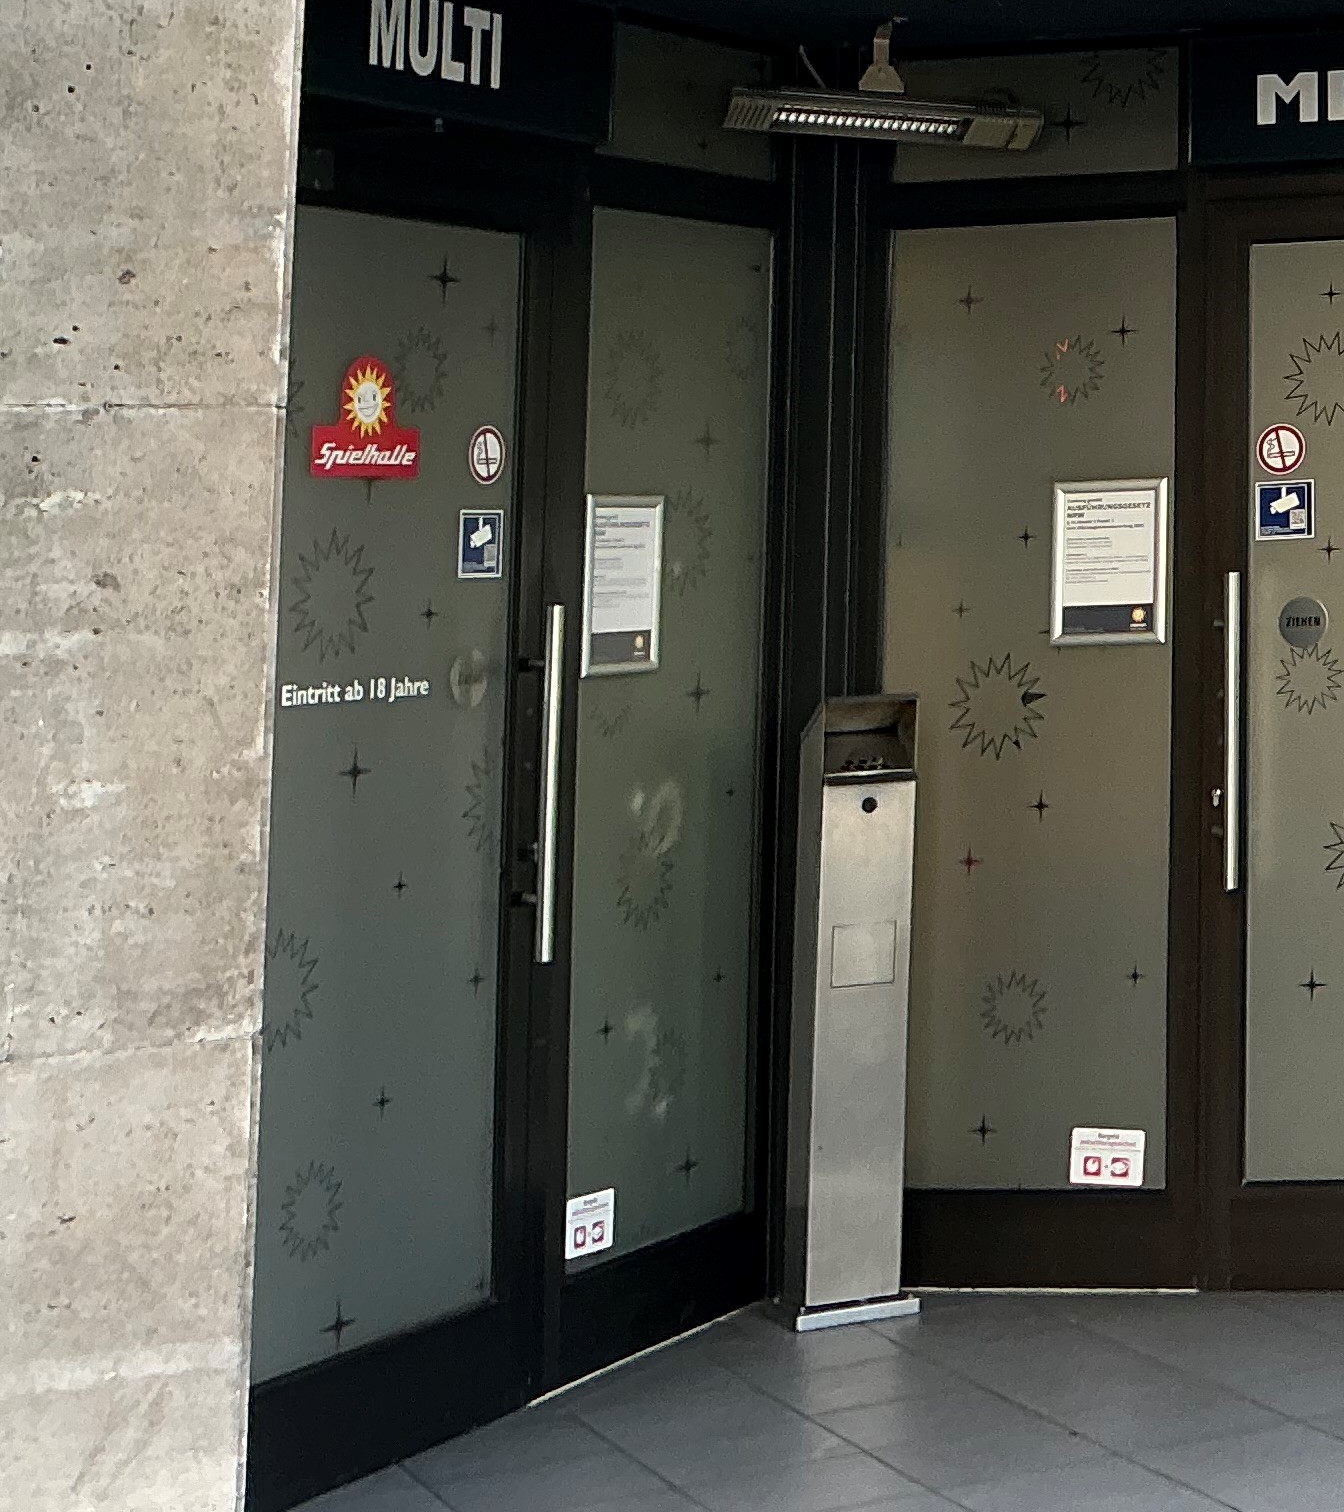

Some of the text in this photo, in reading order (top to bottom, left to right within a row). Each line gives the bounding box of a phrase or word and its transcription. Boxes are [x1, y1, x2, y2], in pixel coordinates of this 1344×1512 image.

[315, 442, 416, 470] Spielhalle
[281, 682, 341, 707] Eintritt
[344, 679, 364, 701] ab
[370, 677, 387, 700] 18
[388, 676, 430, 702] Jahre
